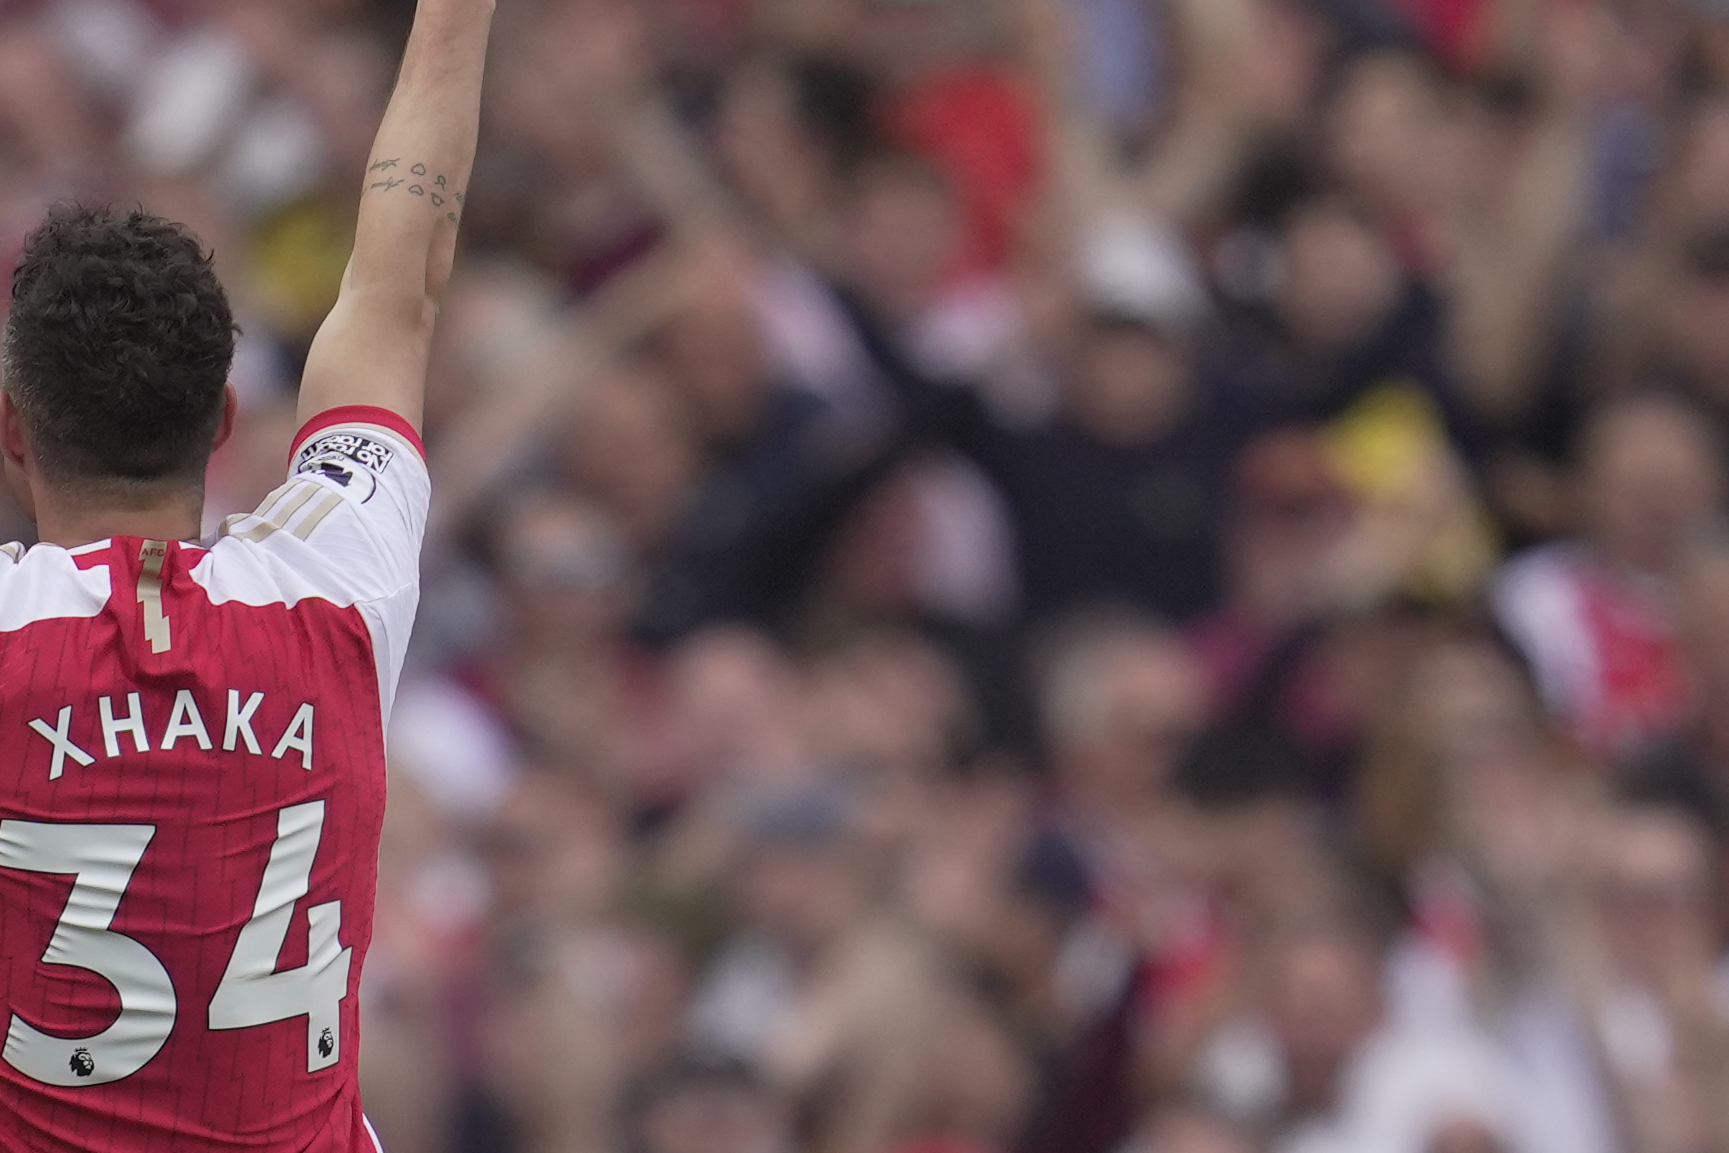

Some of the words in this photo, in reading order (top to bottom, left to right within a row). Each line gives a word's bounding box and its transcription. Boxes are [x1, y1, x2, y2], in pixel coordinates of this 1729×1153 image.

[357, 450, 389, 473] No
[141, 547, 165, 557] AFC
[28, 689, 315, 781] XHAKA
